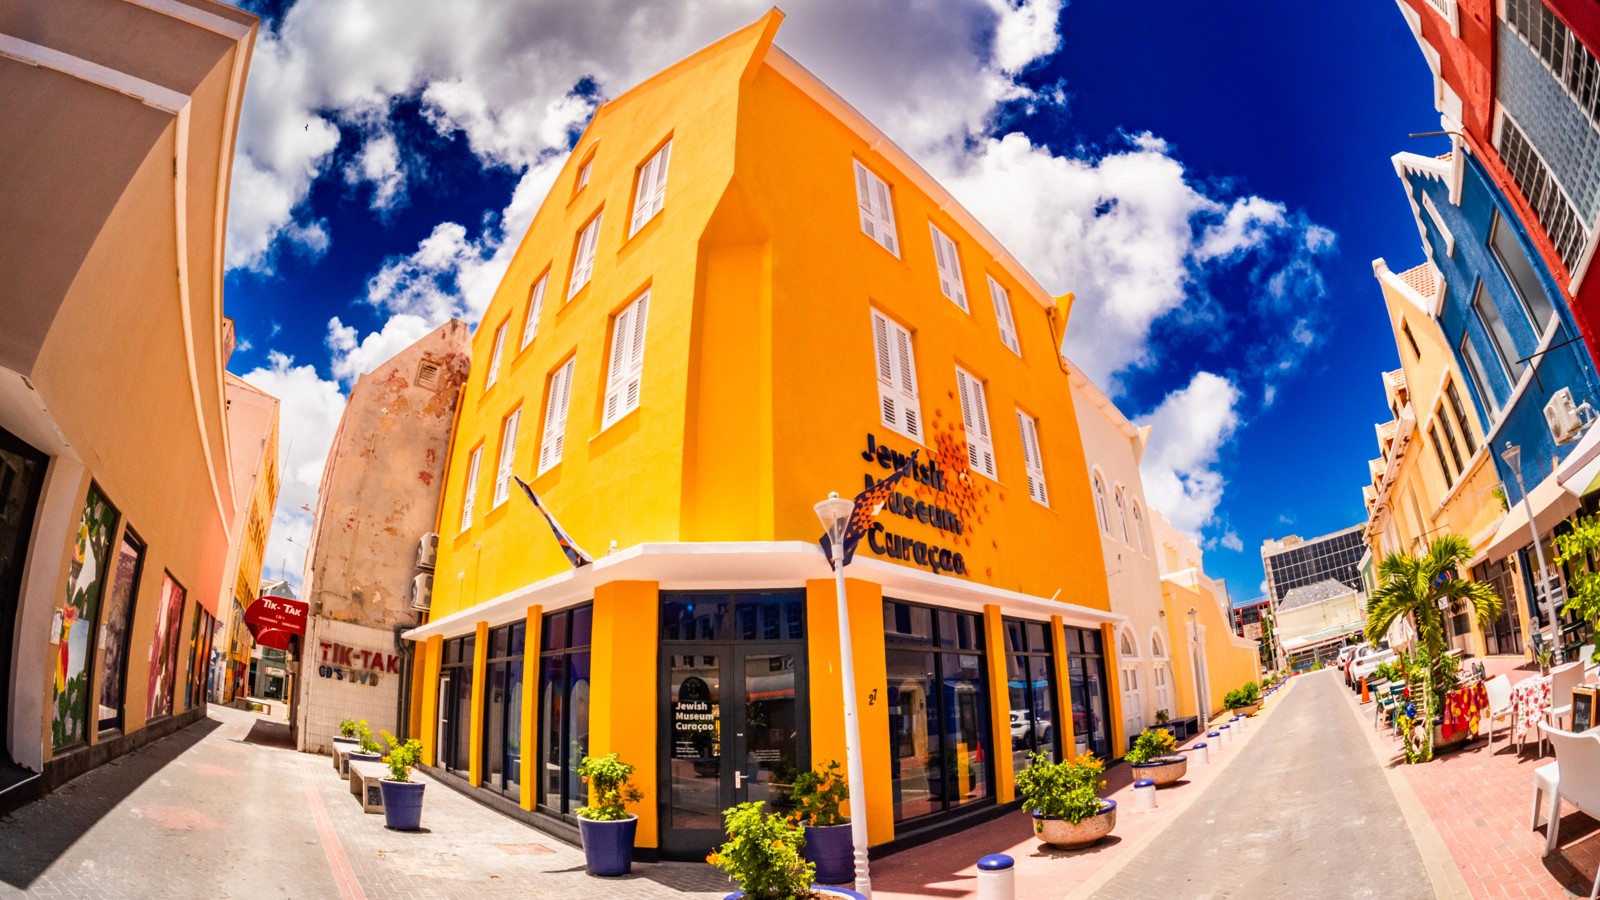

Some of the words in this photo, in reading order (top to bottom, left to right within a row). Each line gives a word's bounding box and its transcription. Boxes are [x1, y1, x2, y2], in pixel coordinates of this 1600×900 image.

[862, 433, 945, 492] Jewish
[868, 522, 965, 575] Curaçao
[319, 642, 400, 674] TIK-TAK
[675, 701, 708, 711] Jewish
[868, 688, 878, 706] 27
[675, 712, 714, 721] Museum
[675, 722, 714, 733] Curaçao
